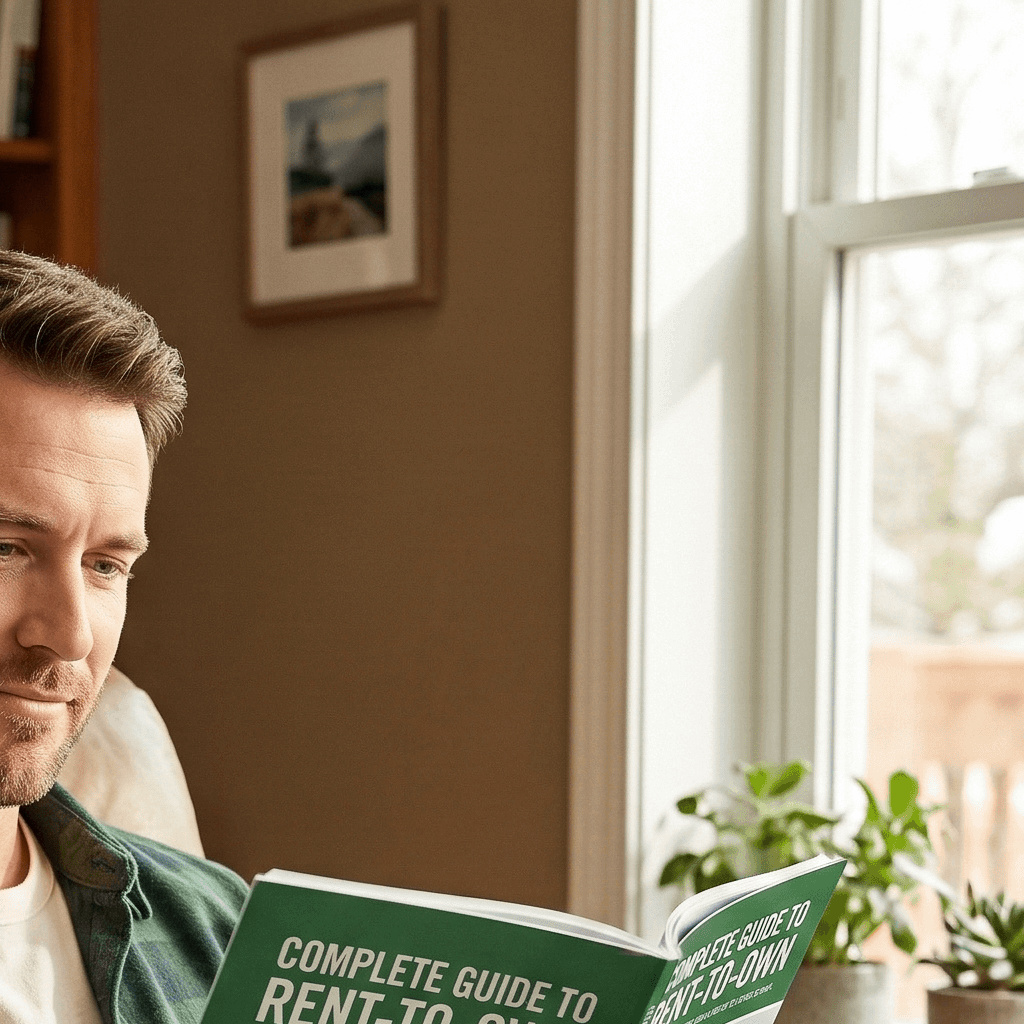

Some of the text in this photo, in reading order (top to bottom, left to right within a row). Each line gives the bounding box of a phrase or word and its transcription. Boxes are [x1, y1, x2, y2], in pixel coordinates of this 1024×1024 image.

[737, 910, 789, 952] GUIDE
[785, 900, 812, 931] TO
[277, 936, 450, 993] COMPLETE
[452, 965, 552, 1014] GUIDE
[550, 987, 598, 1024] TO
